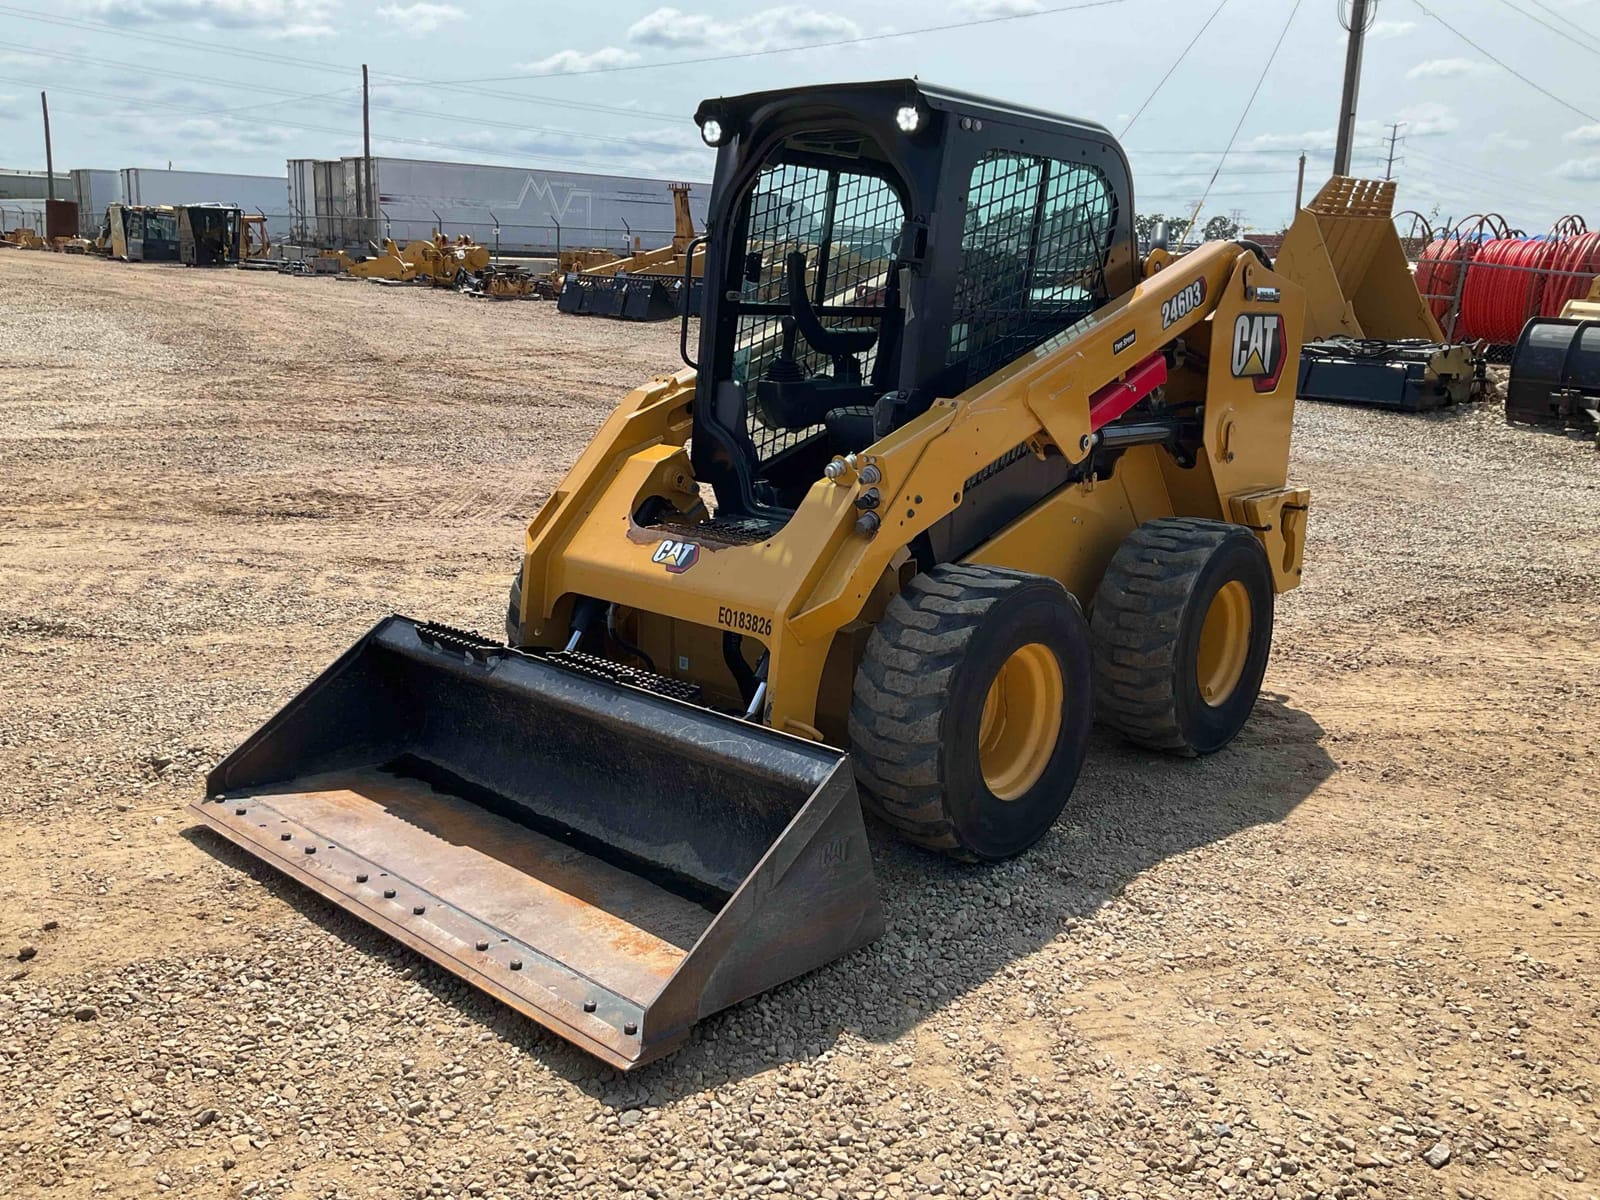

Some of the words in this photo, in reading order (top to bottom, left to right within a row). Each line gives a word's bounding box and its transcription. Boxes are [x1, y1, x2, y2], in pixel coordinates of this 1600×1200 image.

[1162, 281, 1201, 329] 246D3
[1232, 315, 1278, 376] CAT
[653, 540, 695, 567] CAT
[718, 606, 772, 636] EQ183826
[821, 838, 849, 869] CAT
